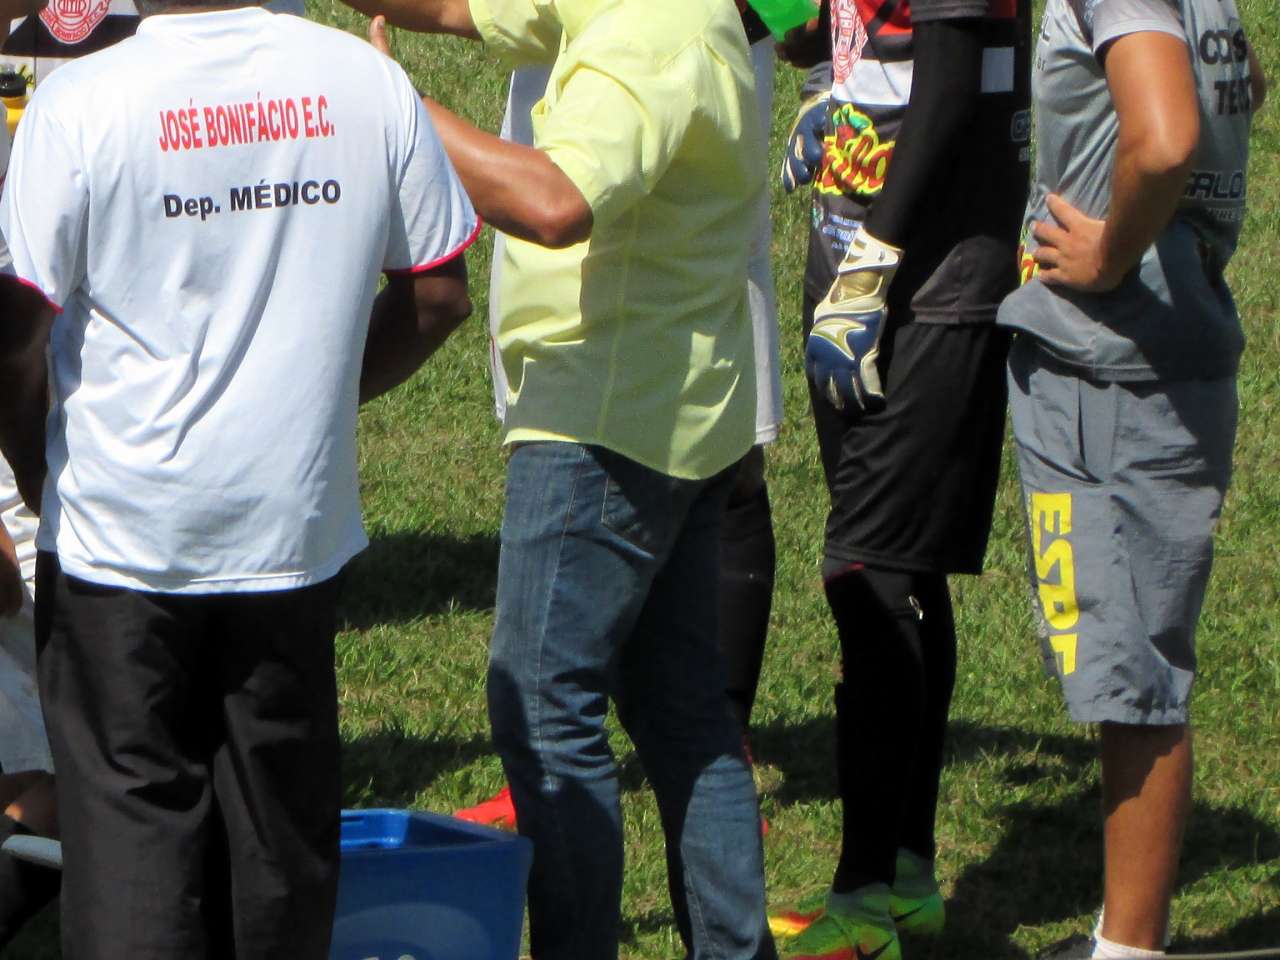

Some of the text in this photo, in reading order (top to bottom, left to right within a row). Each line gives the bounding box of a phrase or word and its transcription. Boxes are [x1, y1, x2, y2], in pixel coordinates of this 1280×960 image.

[159, 91, 336, 152] JOSÉ BONIFÁCIO E.C.
[163, 178, 342, 221] Dep. MÉDICO
